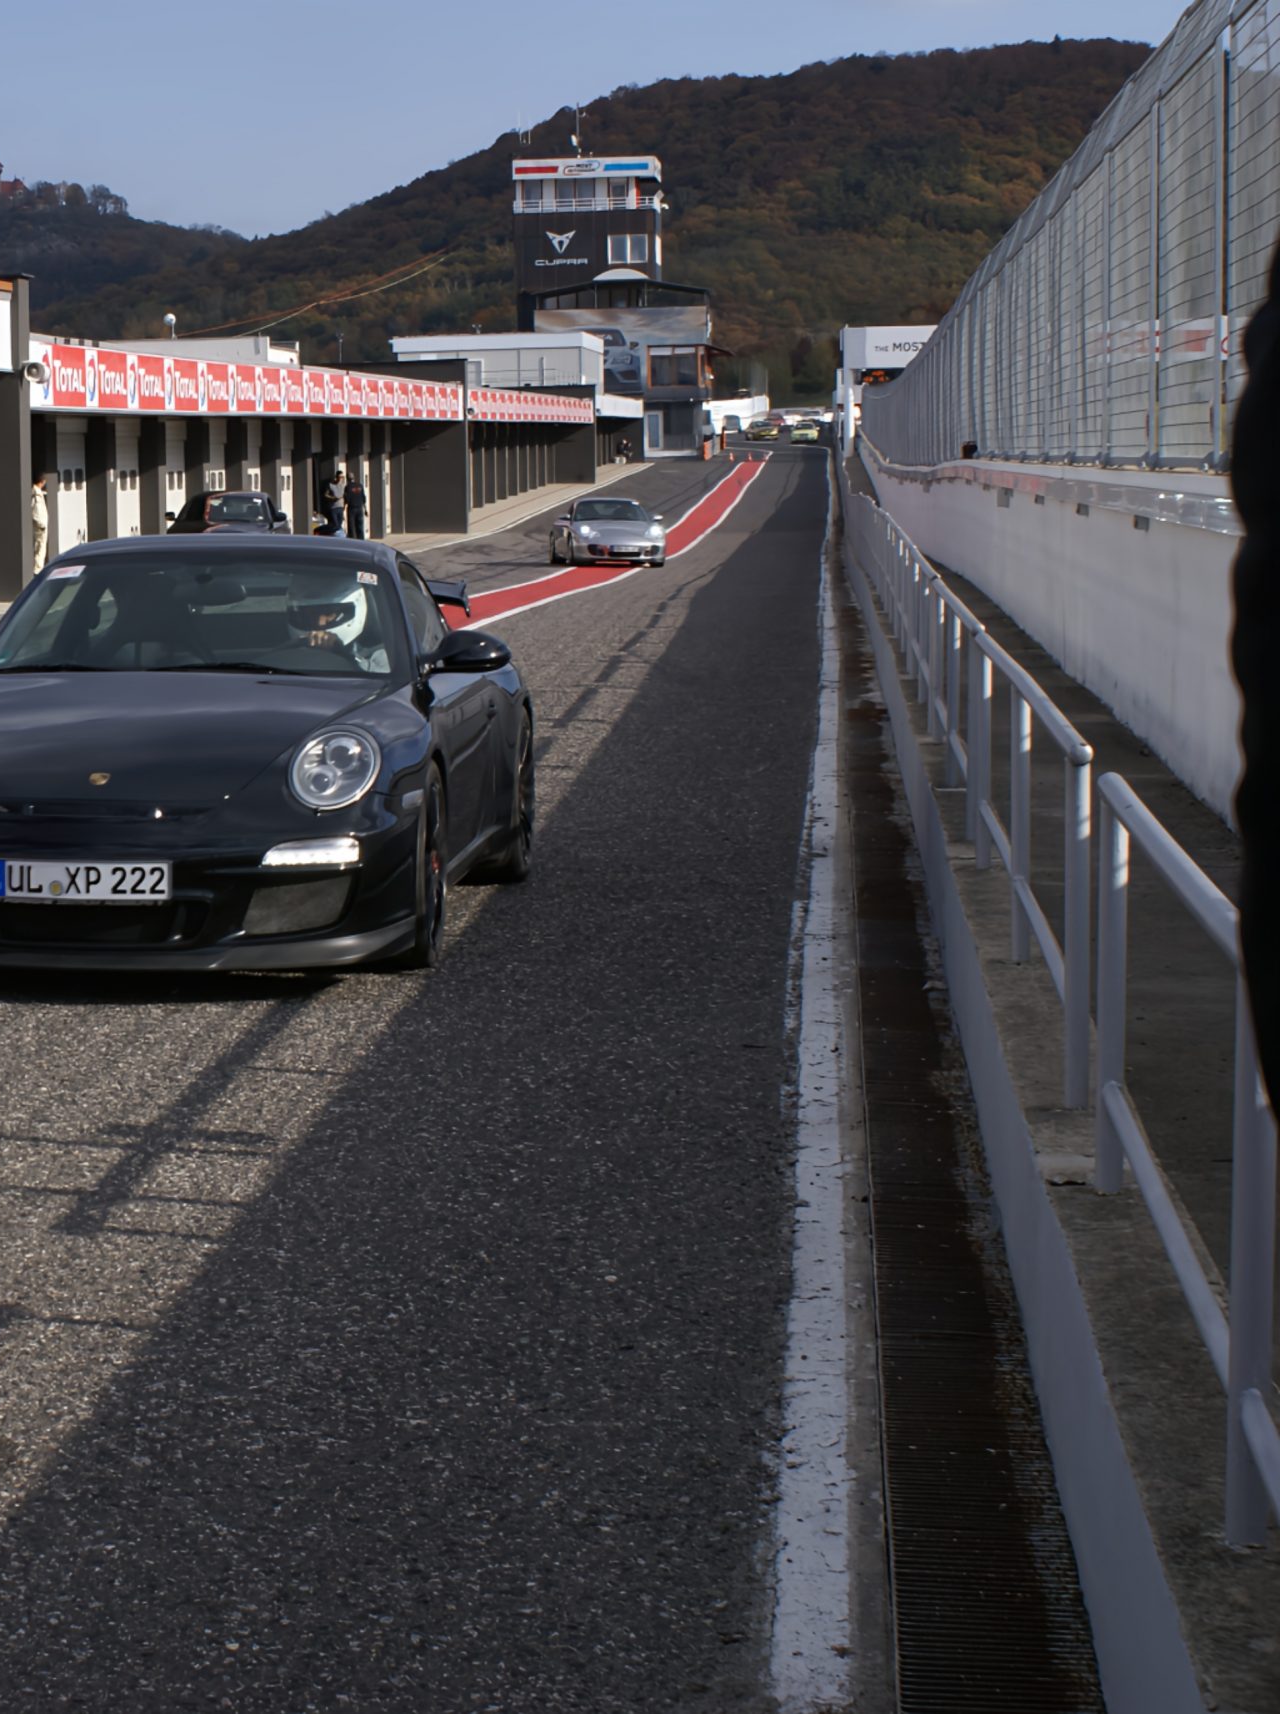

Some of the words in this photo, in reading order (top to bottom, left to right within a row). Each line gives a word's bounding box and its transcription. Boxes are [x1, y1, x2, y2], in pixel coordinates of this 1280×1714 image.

[535, 258, 588, 266] CUPRA
[53, 359, 85, 393] TOTAL
[98, 363, 127, 395] TOTAL
[138, 366, 164, 398] TOTAL
[174, 370, 198, 400] TOTAL
[7, 865, 43, 893] UL
[65, 867, 101, 894] XP
[111, 866, 166, 895] 222
